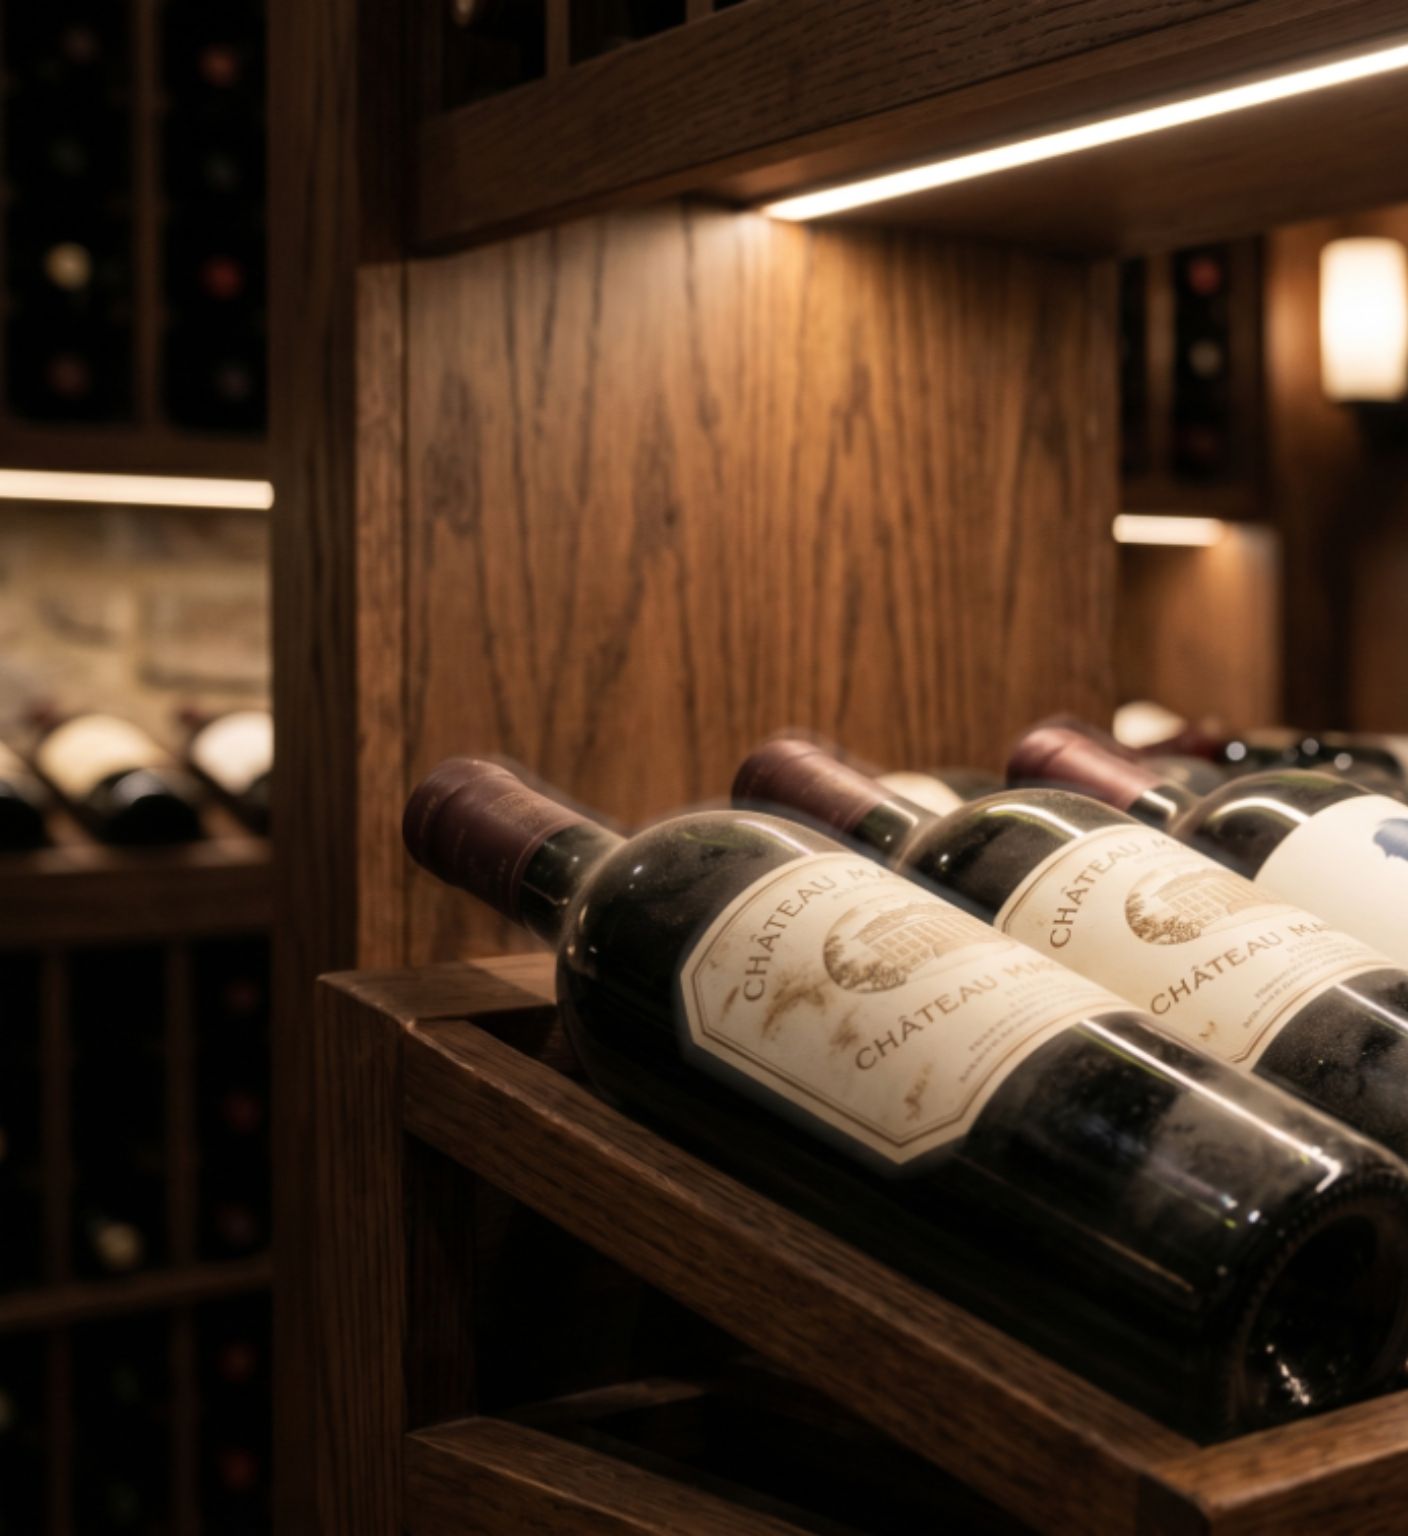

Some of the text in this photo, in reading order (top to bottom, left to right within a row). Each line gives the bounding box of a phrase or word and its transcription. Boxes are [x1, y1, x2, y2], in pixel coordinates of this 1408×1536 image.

[743, 875, 837, 1002] CHÂTEAU
[1050, 841, 1142, 948] CHÂTEAU
[855, 975, 999, 1072] CHÂTEAU
[1150, 931, 1283, 1015] CHÂTEAU
